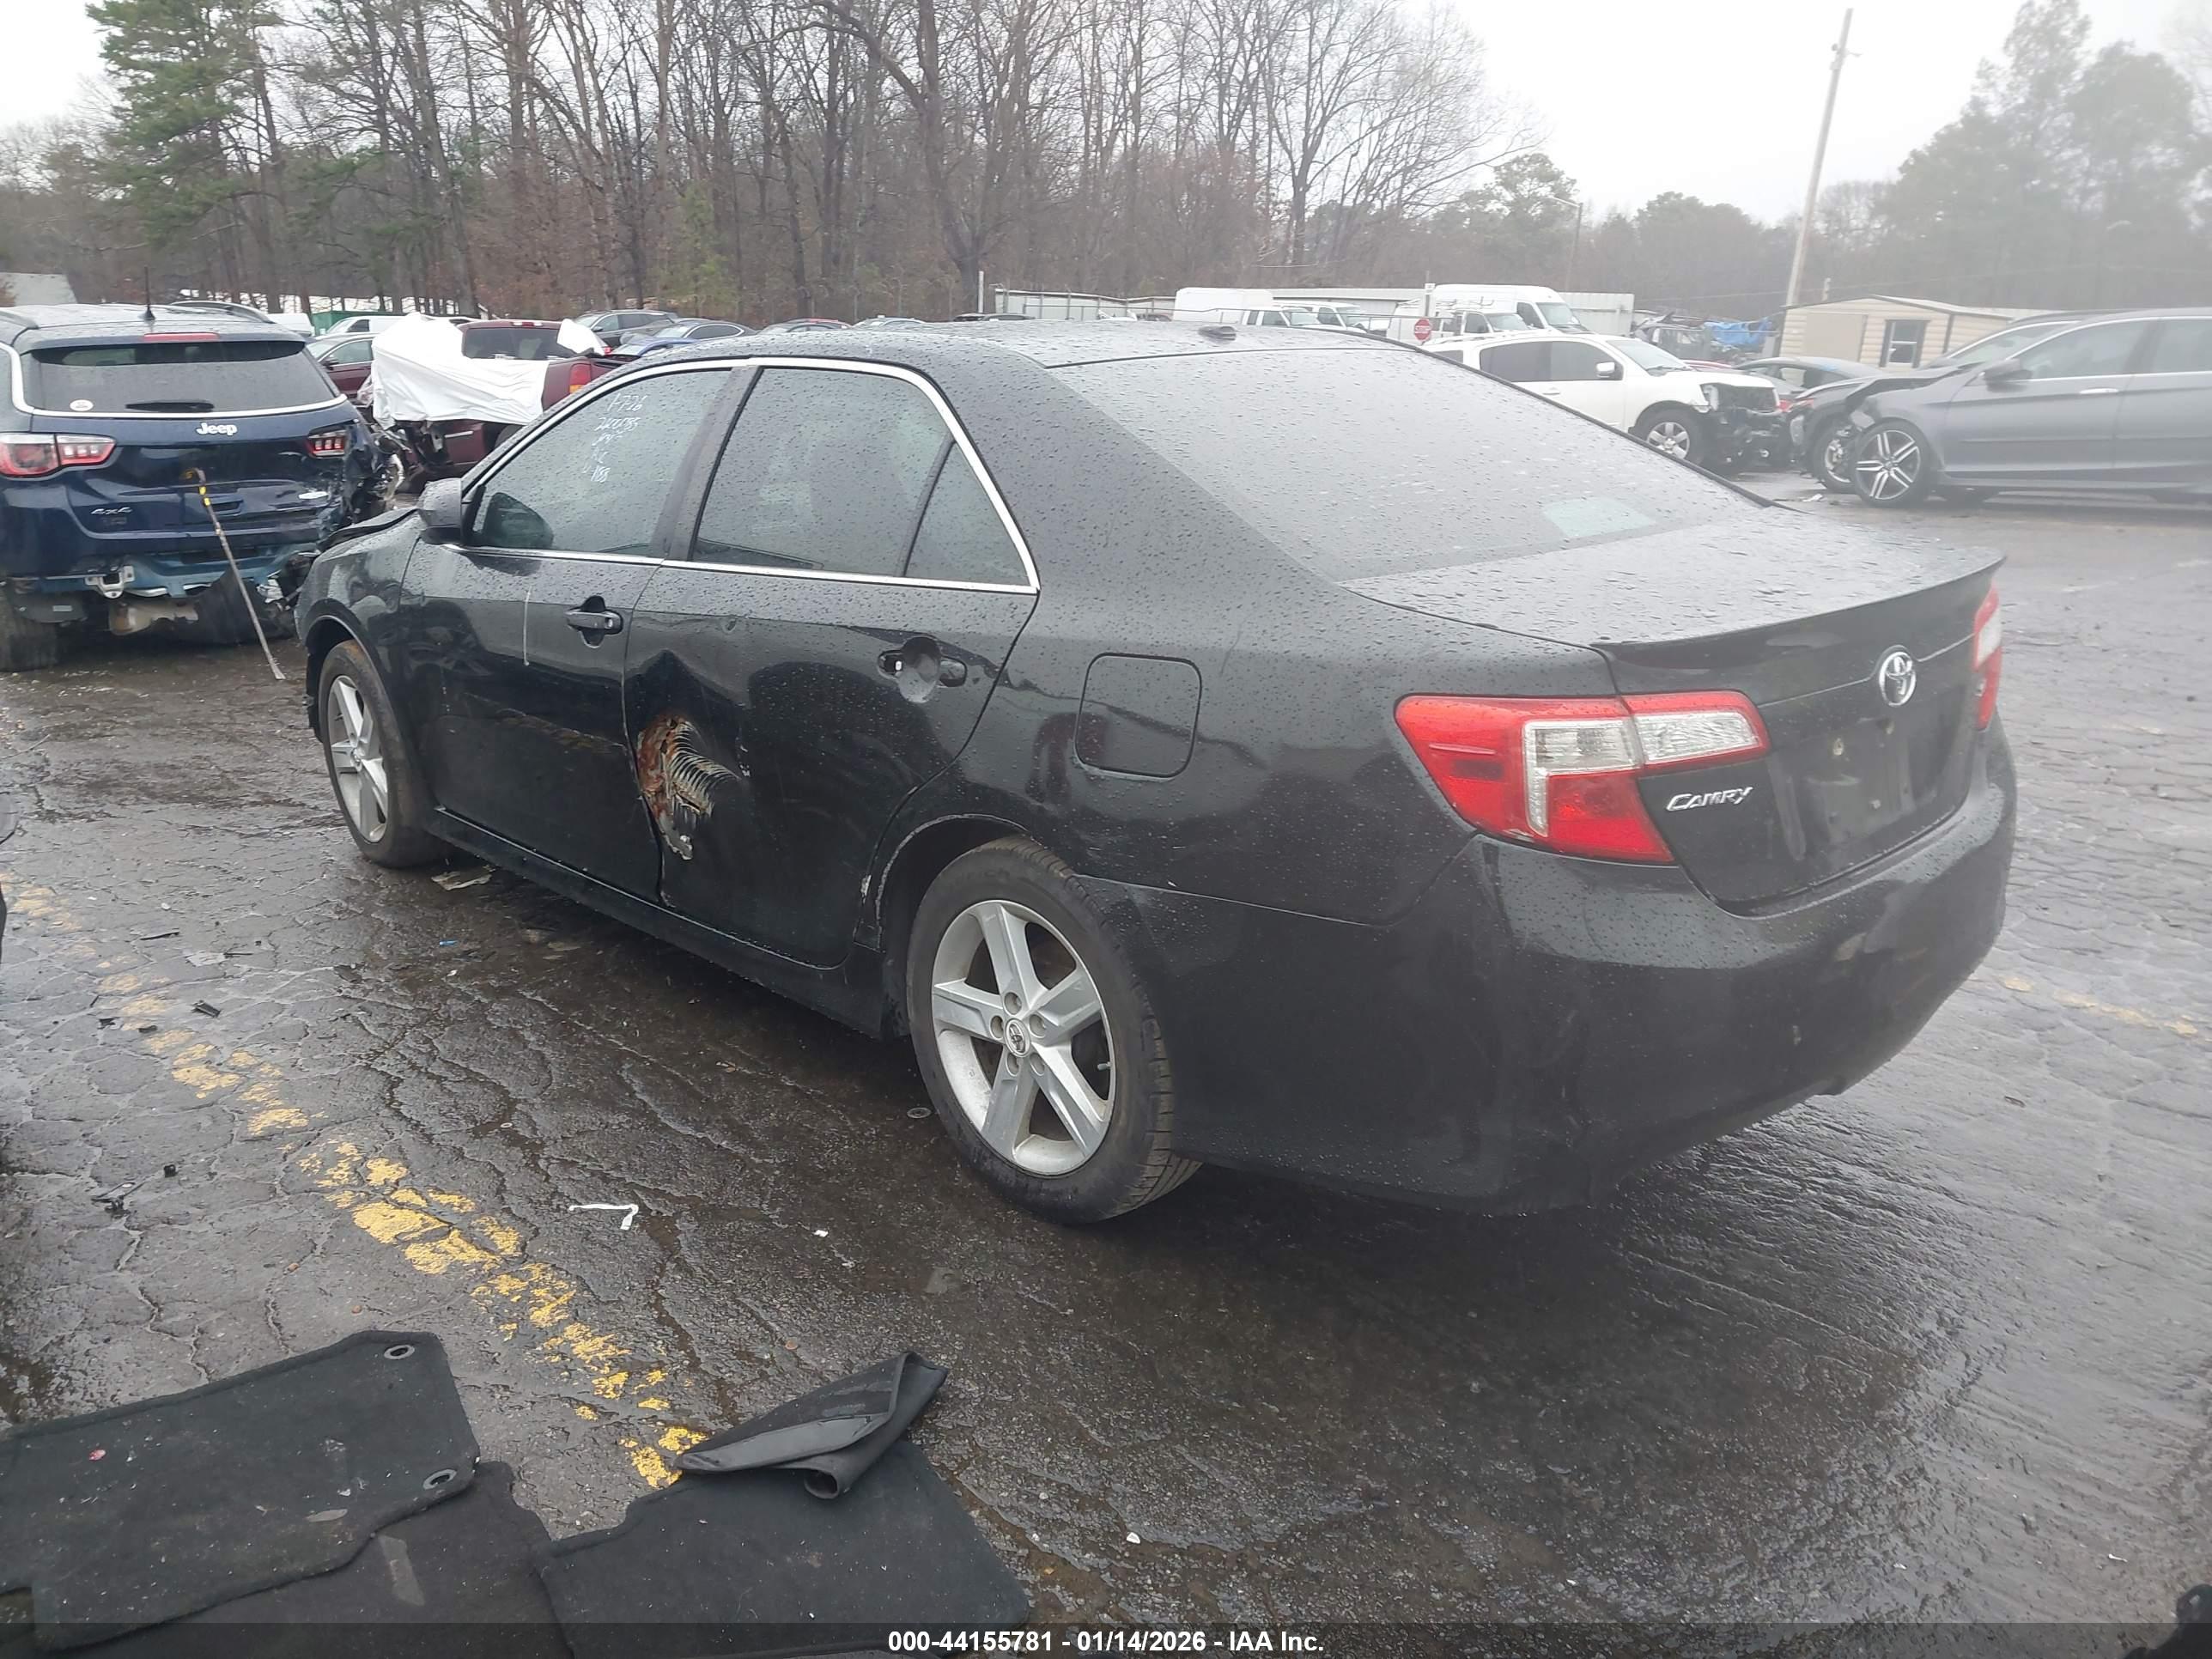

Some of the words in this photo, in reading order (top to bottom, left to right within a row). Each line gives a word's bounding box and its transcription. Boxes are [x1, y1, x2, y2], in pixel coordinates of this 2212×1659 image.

[196, 422, 238, 436] Jeep
[90, 507, 133, 515] 4x4
[1666, 787, 1753, 811] CAMRY
